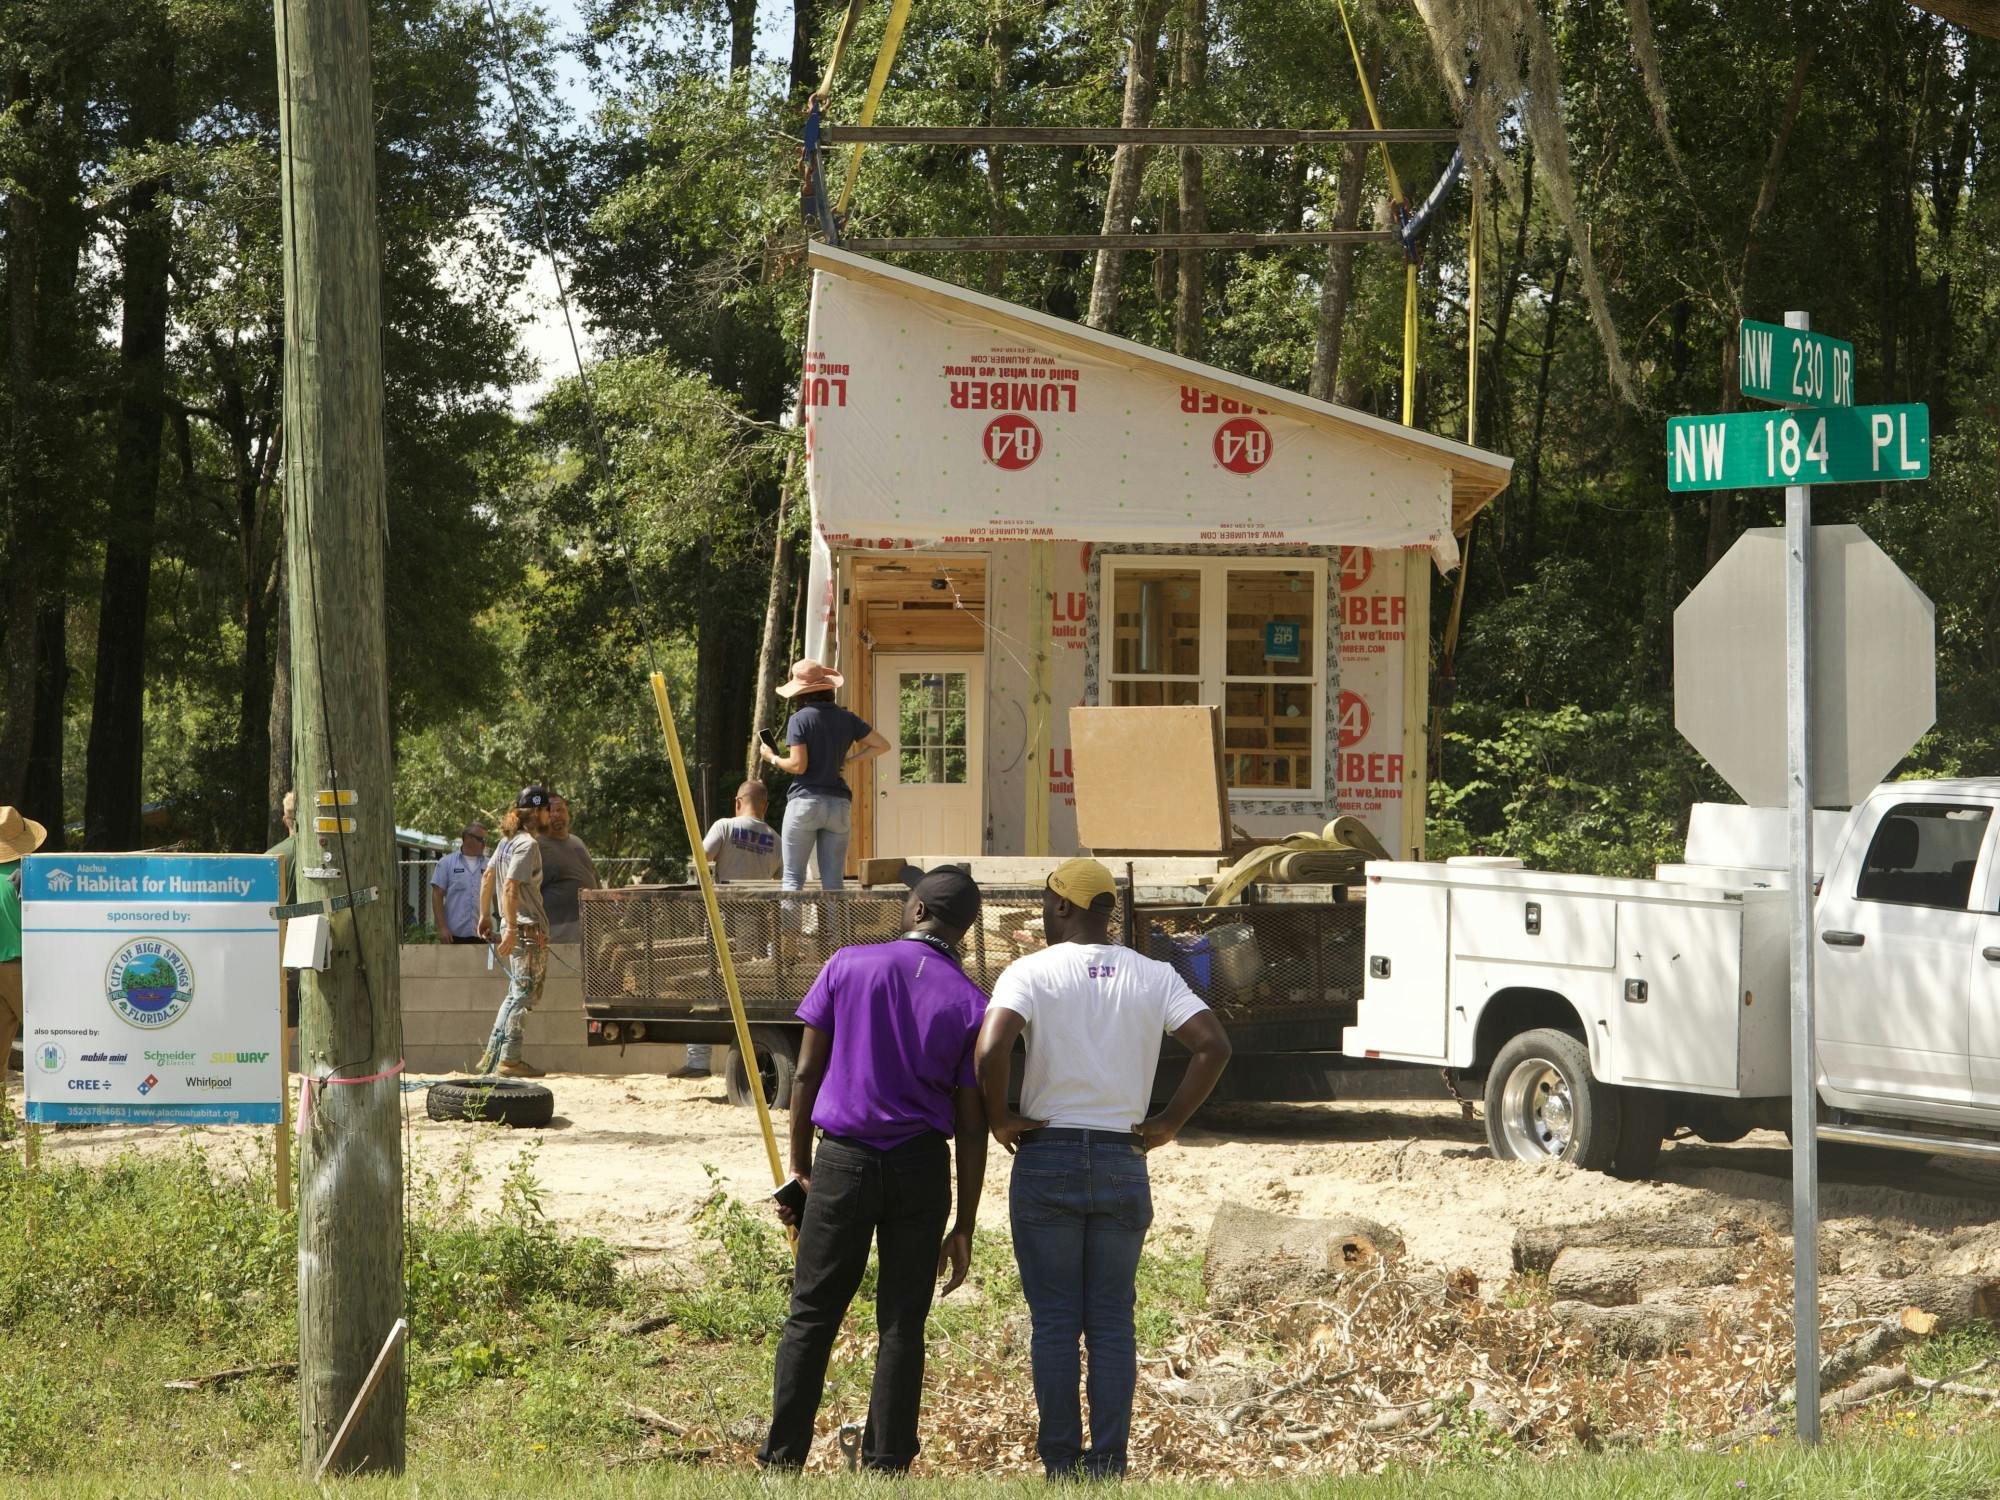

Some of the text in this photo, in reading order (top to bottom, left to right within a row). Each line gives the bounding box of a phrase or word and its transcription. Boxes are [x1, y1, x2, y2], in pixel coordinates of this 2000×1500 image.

[979, 366, 996, 377] we
[999, 366, 1028, 379] what
[1030, 368, 1046, 379] on
[1744, 328, 1851, 408] NW 230 DR
[1049, 369, 1080, 381] Build
[950, 381, 1077, 413] LUMBER
[990, 426, 1036, 461] 84
[1220, 430, 1266, 464] 84
[1675, 412, 1921, 483] NW 184 PL
[1340, 596, 1406, 626] BER
[1358, 631, 1376, 641] we
[1337, 752, 1404, 783] BER
[1355, 788, 1373, 799] we
[77, 864, 107, 873] Alachua
[76, 875, 250, 897] Habitat for Humanity
[107, 910, 191, 923] sponsored by:
[110, 942, 189, 988] CITY OF HIGH SPRINGS
[127, 1007, 170, 1024] FLORIDA
[34, 1028, 100, 1037] also sponsored by:
[80, 1052, 128, 1062] mobile mini
[144, 1050, 197, 1061] Schneider
[210, 1052, 270, 1064] SUBWAY
[67, 1079, 101, 1090] CREE
[185, 1076, 232, 1090] Whirlpool
